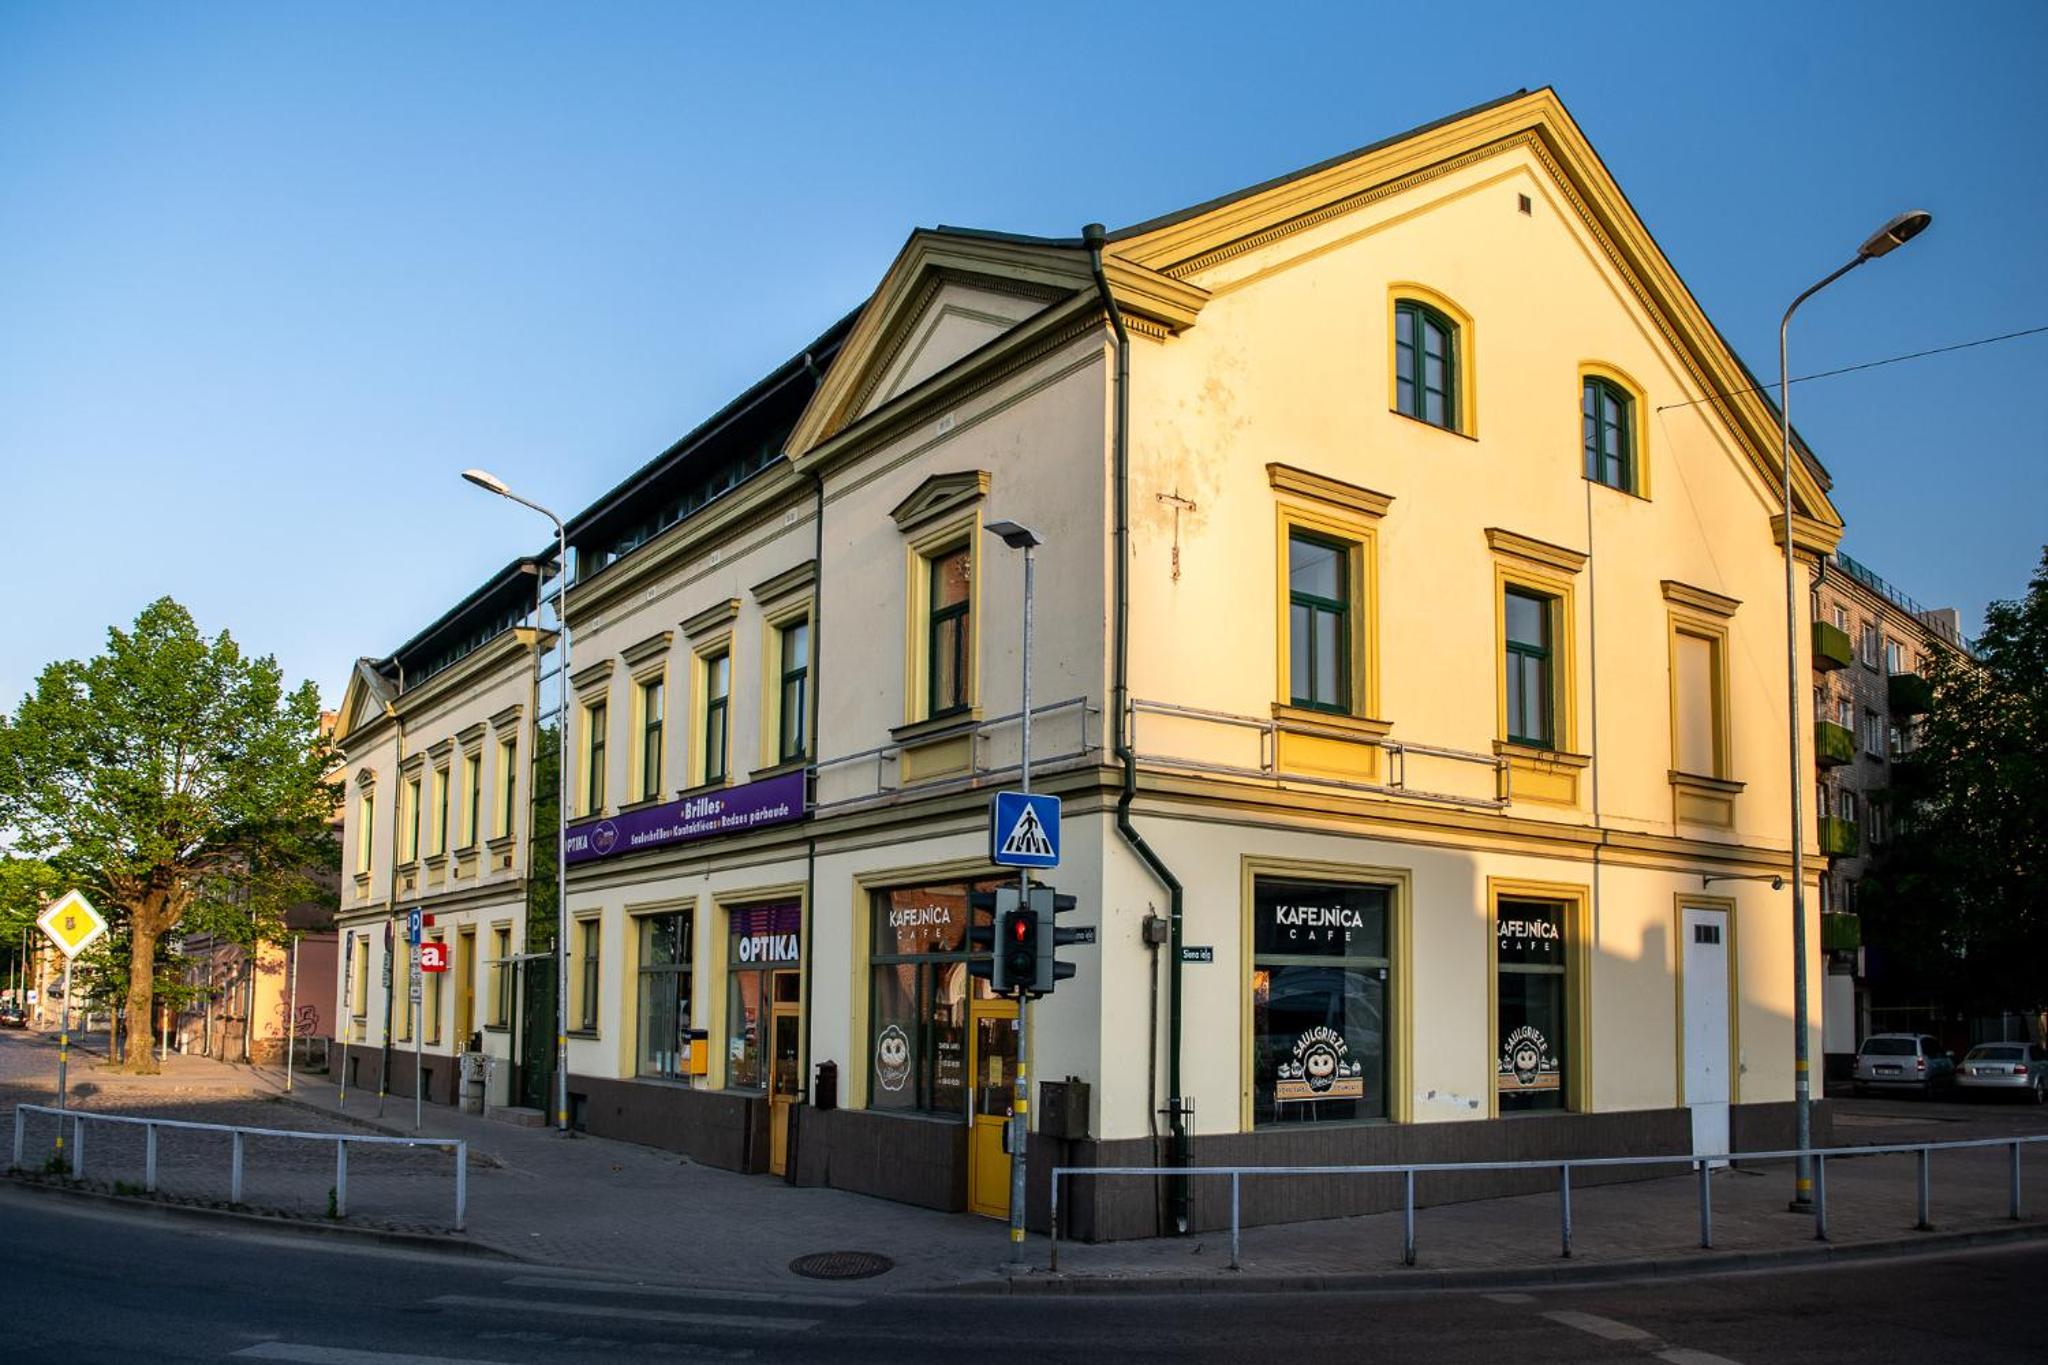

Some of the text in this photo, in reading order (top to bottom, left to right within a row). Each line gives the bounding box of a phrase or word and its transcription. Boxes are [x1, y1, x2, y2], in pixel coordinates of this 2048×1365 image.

[684, 797, 720, 820] Brilles
[721, 812, 748, 828] Redzes
[749, 802, 789, 825] pārbaude
[565, 834, 588, 853] PTIKA
[889, 904, 951, 928] KAFEJNĪCA
[1276, 905, 1363, 928] KAFEJNĪCA
[897, 928, 941, 940] CAFE
[1289, 928, 1352, 942] CAFE
[1501, 940, 1550, 951] CAFE
[739, 934, 800, 962] OPTIKA
[1293, 1026, 1349, 1059] SAULGRIEZE
[1505, 1025, 1549, 1054] SAULGRIEZE
